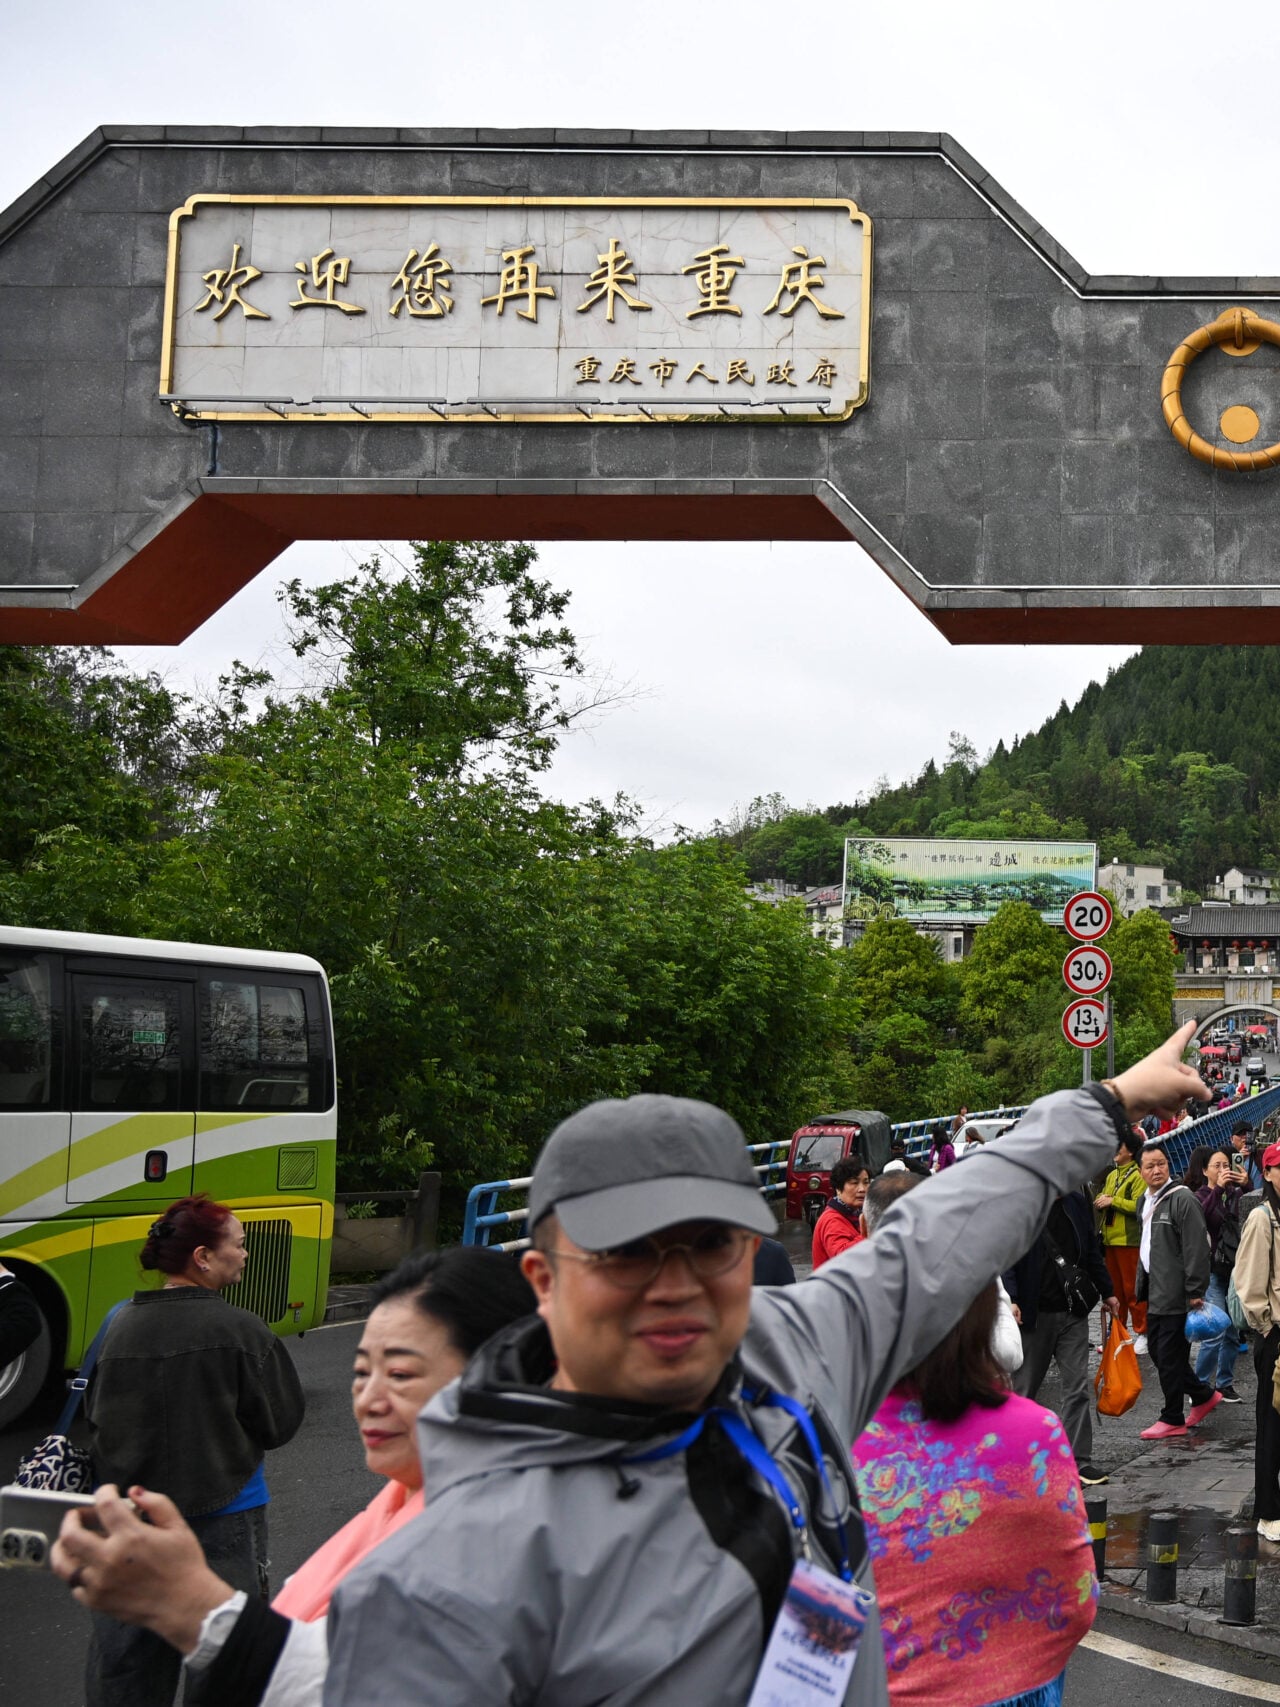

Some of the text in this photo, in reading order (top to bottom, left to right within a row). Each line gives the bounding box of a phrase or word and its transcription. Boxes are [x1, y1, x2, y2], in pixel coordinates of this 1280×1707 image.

[196, 238, 847, 323] 欢迎您再来重庆
[573, 356, 838, 388] 重庆市人民政府
[1075, 906, 1103, 927] 20
[1071, 960, 1103, 981] 30t
[1076, 1009, 1098, 1025] 13t
